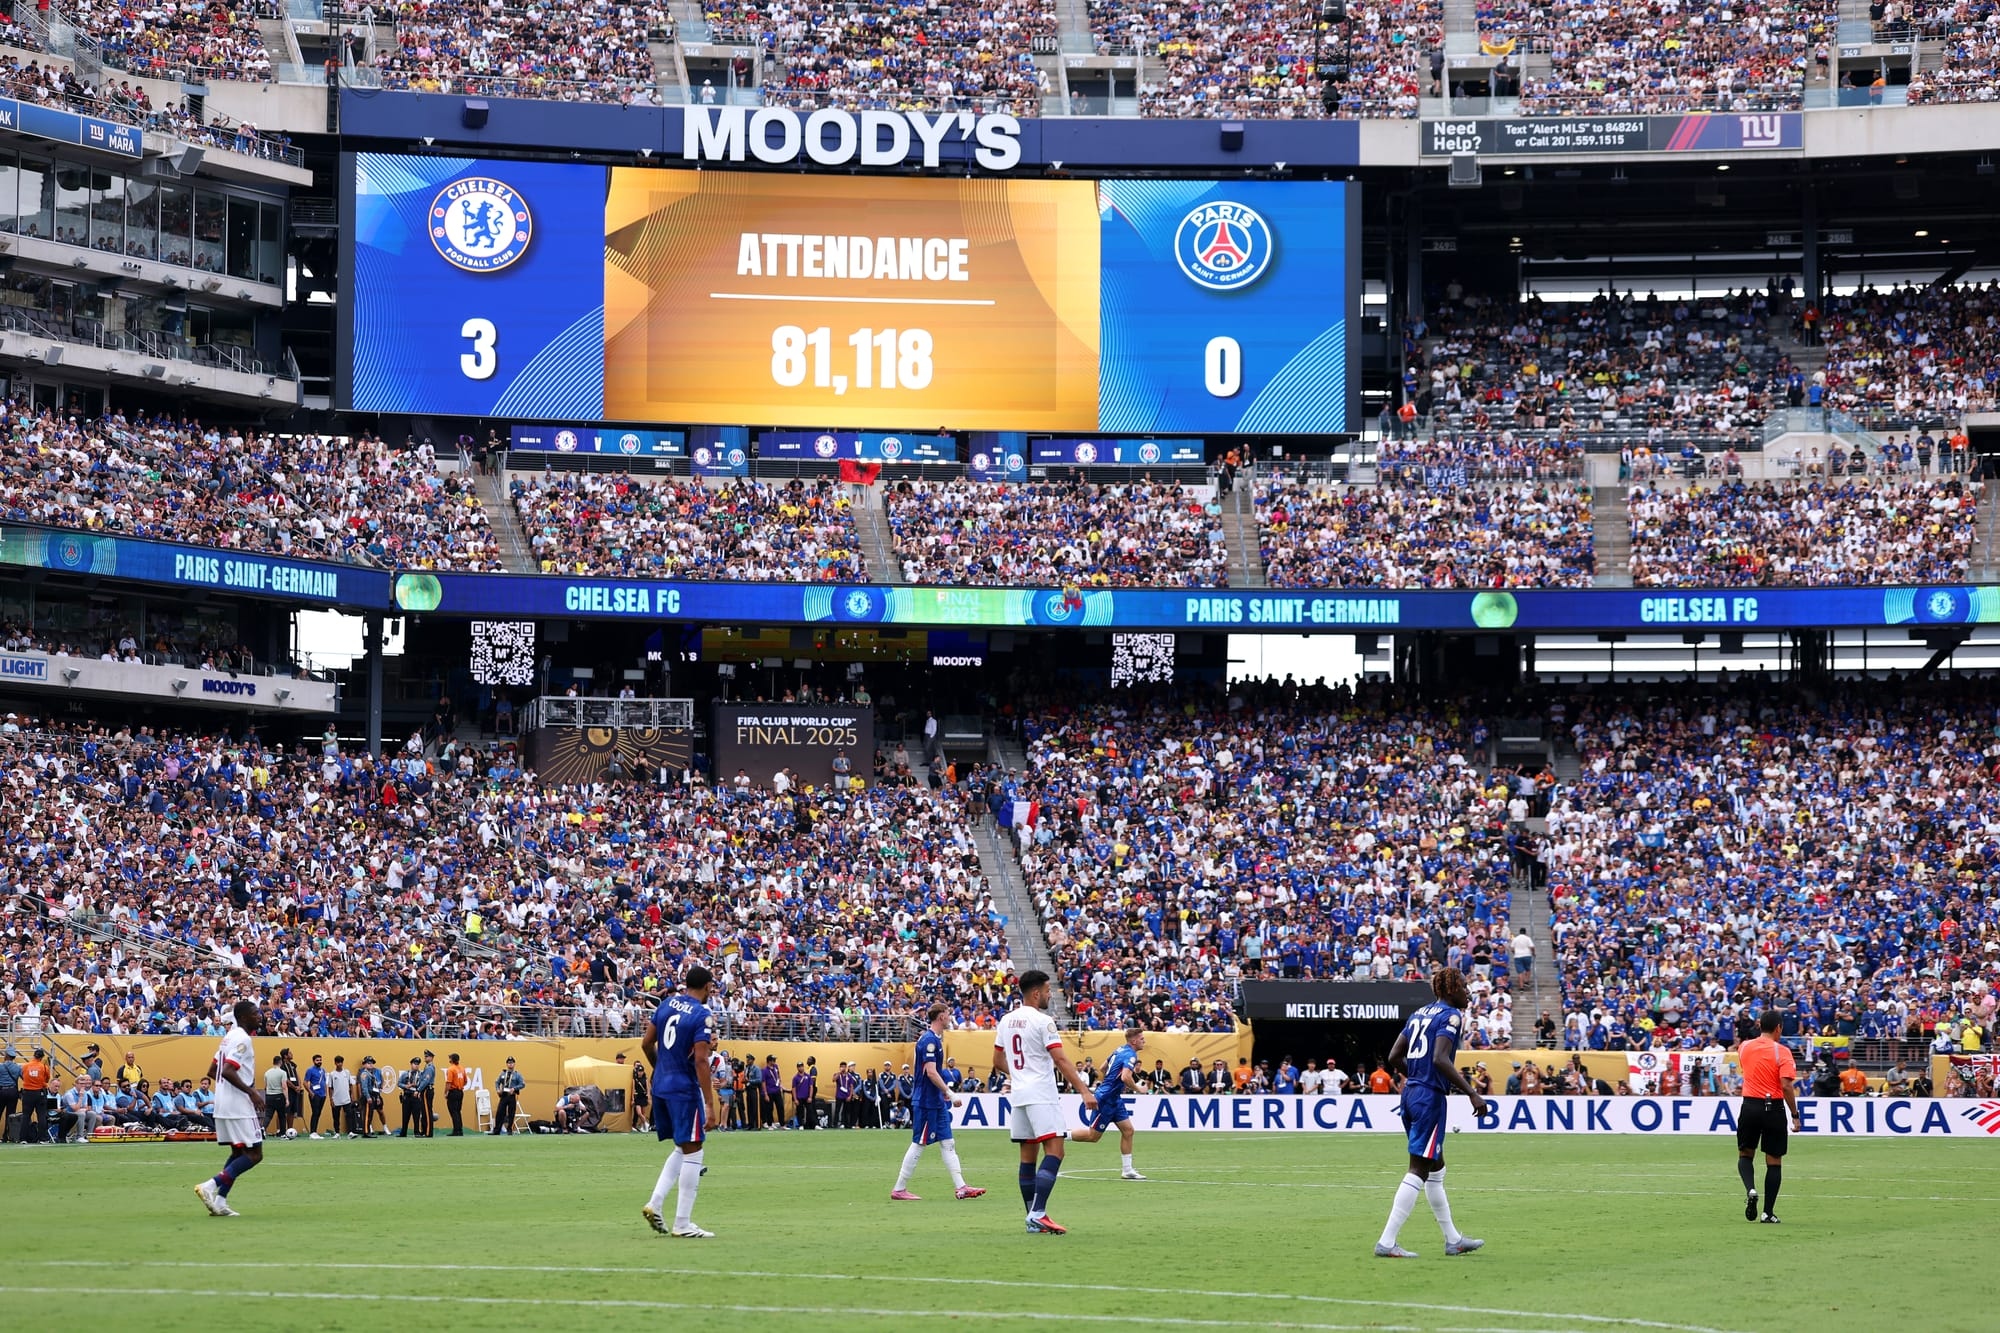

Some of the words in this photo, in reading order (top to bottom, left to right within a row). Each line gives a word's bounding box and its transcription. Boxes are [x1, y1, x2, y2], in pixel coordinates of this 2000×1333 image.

[114, 125, 130, 137] JACK
[683, 105, 1022, 170] MOODY'S
[1433, 121, 1477, 135] Need
[1505, 124, 1527, 135] Text
[1592, 123, 1604, 133] to
[1605, 121, 1644, 133] 848261
[108, 134, 135, 153] MARA
[1433, 136, 1482, 151] Help?
[1515, 138, 1528, 147] or
[1529, 136, 1550, 147] Call
[1551, 134, 1625, 147] 201.559.1515
[447, 180, 514, 204] CHELSEA
[1189, 205, 1255, 228] PARIS
[445, 247, 490, 267] FOOTBALL
[492, 249, 515, 265] CLUB
[737, 233, 969, 282] ATTENDANCE
[1191, 262, 1214, 281] SAINT
[1219, 263, 1255, 282] GERMAIN
[460, 318, 497, 381] 3
[771, 325, 934, 396] 81,118
[1205, 336, 1241, 397] 0
[175, 553, 220, 584] PARIS
[224, 560, 338, 598] SAINT-GERMAIN
[565, 586, 650, 613] CHELSEA
[656, 589, 681, 614] FC
[937, 591, 981, 606] FINAL
[943, 606, 979, 622] 2025
[1186, 598, 1243, 623] PARIS
[1249, 598, 1400, 624] SAINT-GERMAIN
[1640, 597, 1727, 623] CHELSEA
[1733, 597, 1758, 622] FC
[2, 658, 45, 676] LIGHT
[933, 656, 982, 667] MOODY'S
[202, 679, 256, 695] MOODY'S
[737, 716, 760, 726] FIFA
[761, 717, 789, 726] CLUB
[790, 717, 829, 727] WORLD
[737, 727, 802, 745] FINAL
[806, 728, 857, 746] 2025
[1286, 1003, 1340, 1019] METLIFE
[1342, 1004, 1400, 1020] STADIUM
[663, 1013, 681, 1050] 6
[1407, 1018, 1432, 1059] 23
[1012, 1034, 1025, 1070] 9
[1151, 1097, 1373, 1130] AMERICA
[1477, 1098, 1613, 1131] BANK
[1630, 1099, 1693, 1132] OF
[1709, 1100, 1952, 1134] AERICA
